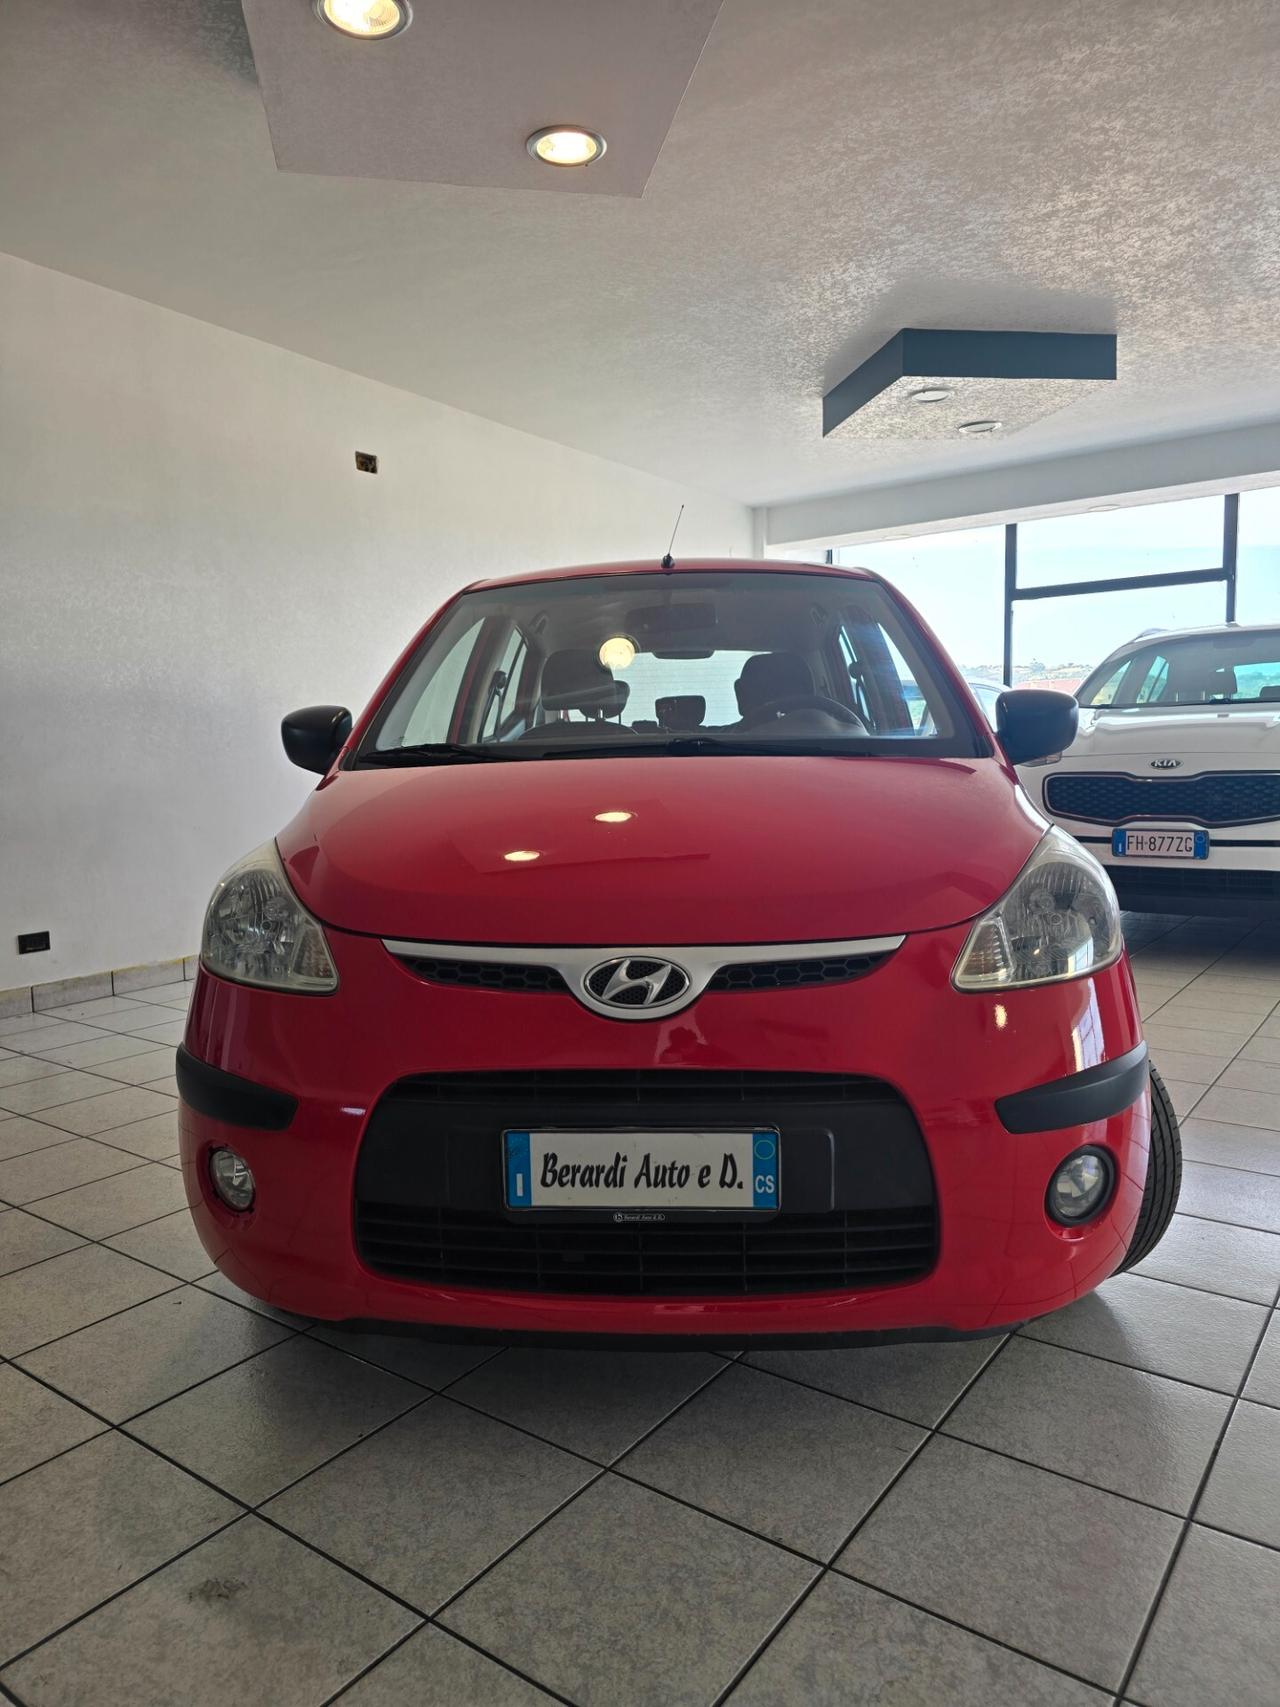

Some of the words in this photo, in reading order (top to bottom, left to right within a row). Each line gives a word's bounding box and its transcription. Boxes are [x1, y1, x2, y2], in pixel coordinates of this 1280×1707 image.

[1153, 759, 1177, 768] KIA
[540, 1152, 628, 1189] Berardi
[634, 1152, 691, 1189] Auto
[697, 1164, 711, 1188] e
[719, 1153, 744, 1190] D.
[754, 1175, 775, 1194] CS
